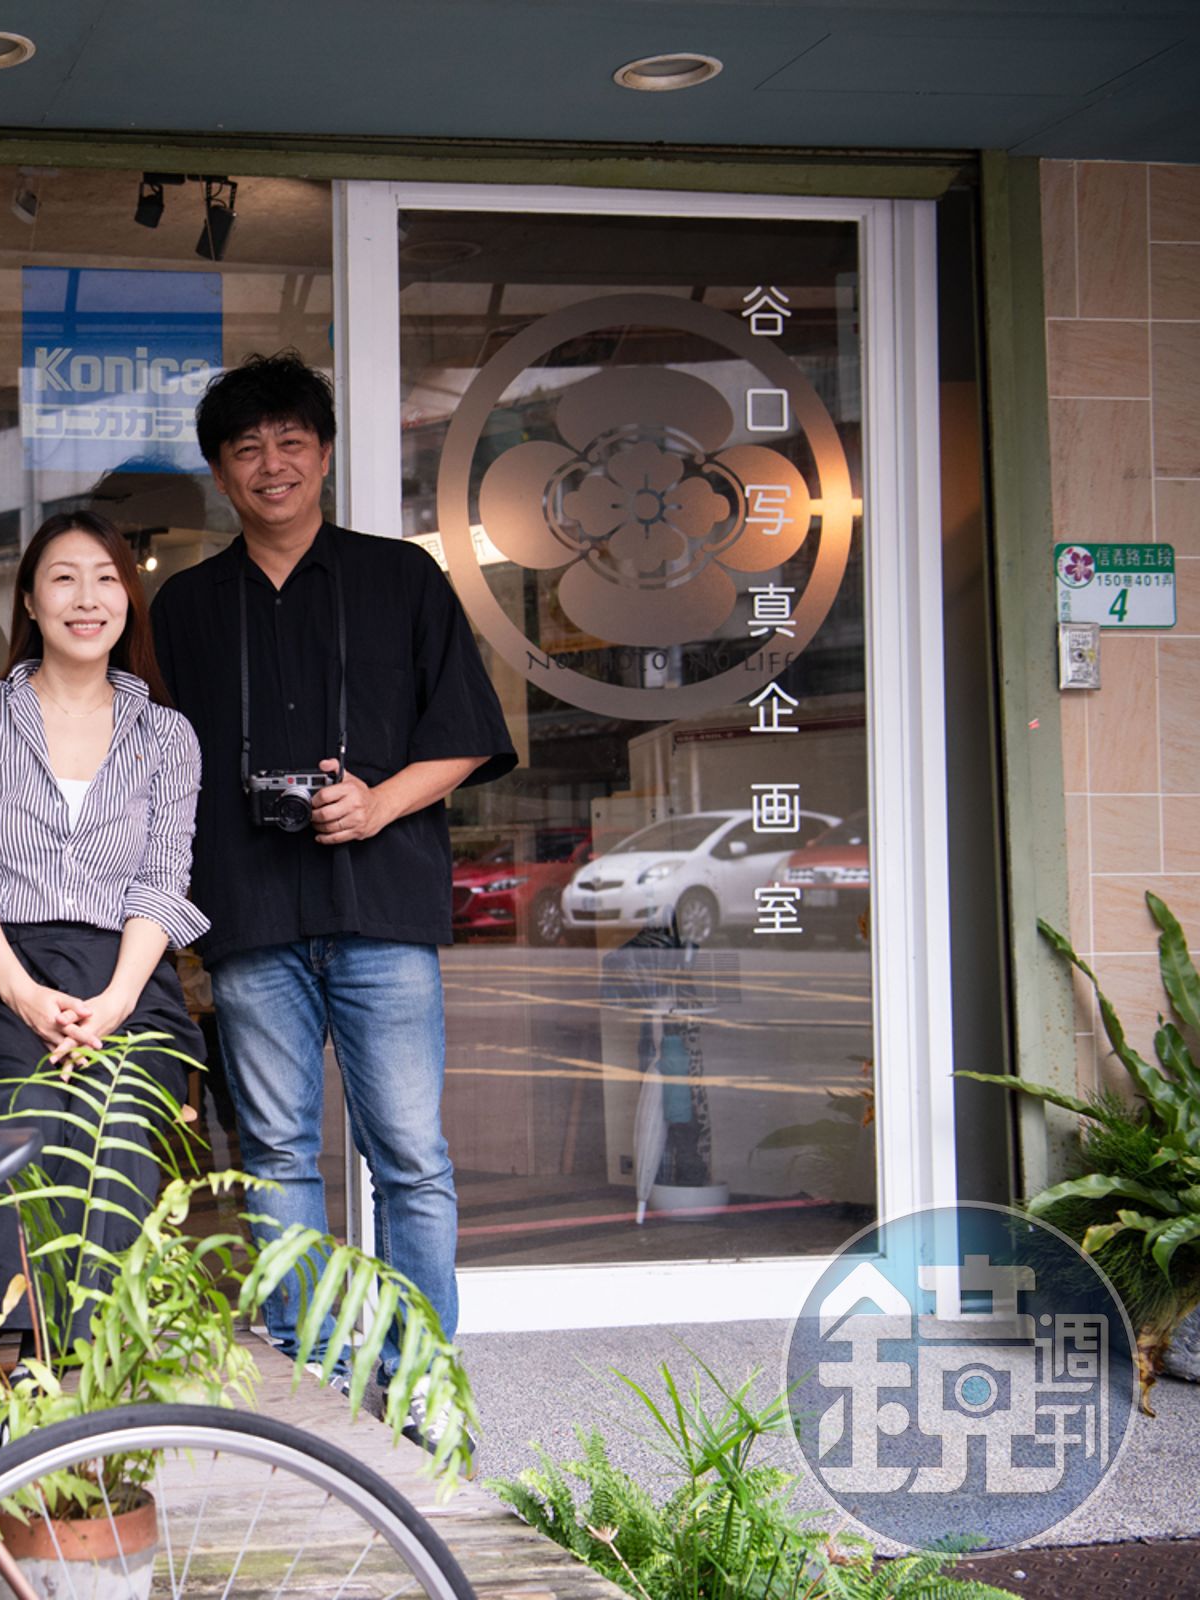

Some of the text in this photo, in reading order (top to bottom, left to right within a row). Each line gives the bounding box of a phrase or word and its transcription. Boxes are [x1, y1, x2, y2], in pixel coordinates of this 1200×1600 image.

[34, 346, 211, 396] Konica
[1096, 547, 1173, 567] 信義路五段
[743, 286, 802, 934] 谷口写真企画室
[1108, 588, 1129, 623] 4
